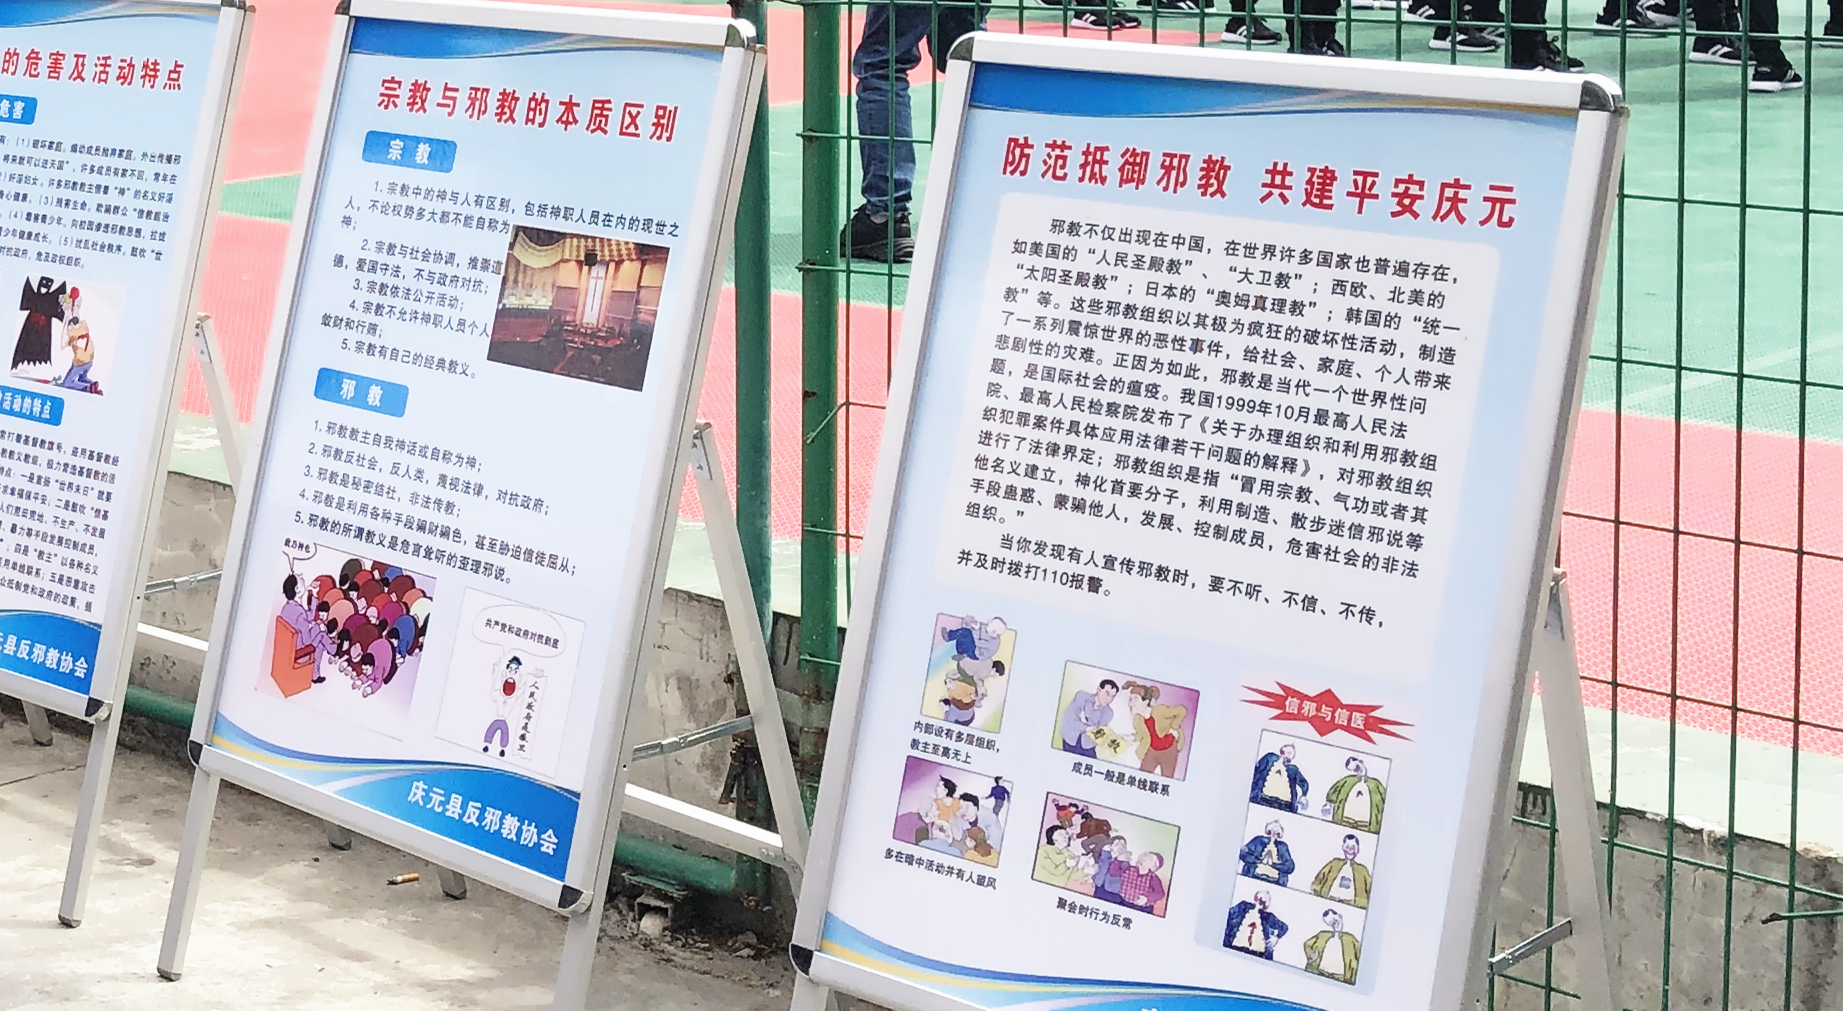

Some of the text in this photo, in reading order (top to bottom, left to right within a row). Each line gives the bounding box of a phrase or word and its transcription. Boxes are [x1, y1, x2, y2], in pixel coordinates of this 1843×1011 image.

[377, 76, 678, 142] 宗教与邪教的本质区别
[387, 138, 431, 164] 宗教
[1002, 136, 1516, 228] 防范抵御邪教 共建平安庆元
[1048, 218, 1457, 284] 邪教不仅出现在中国，在世界许多国家也普遍存在，
[339, 378, 383, 406] 邪教
[957, 548, 1110, 596] 并及时拨打110报警。
[1284, 696, 1366, 729] 信邪与信医
[910, 737, 971, 764] 教主至高无上
[1071, 761, 1170, 796] 成员一般是单线联系
[407, 771, 558, 855] 庆元县反邪教协会
[1056, 896, 1132, 930] 聚会时行为反常
